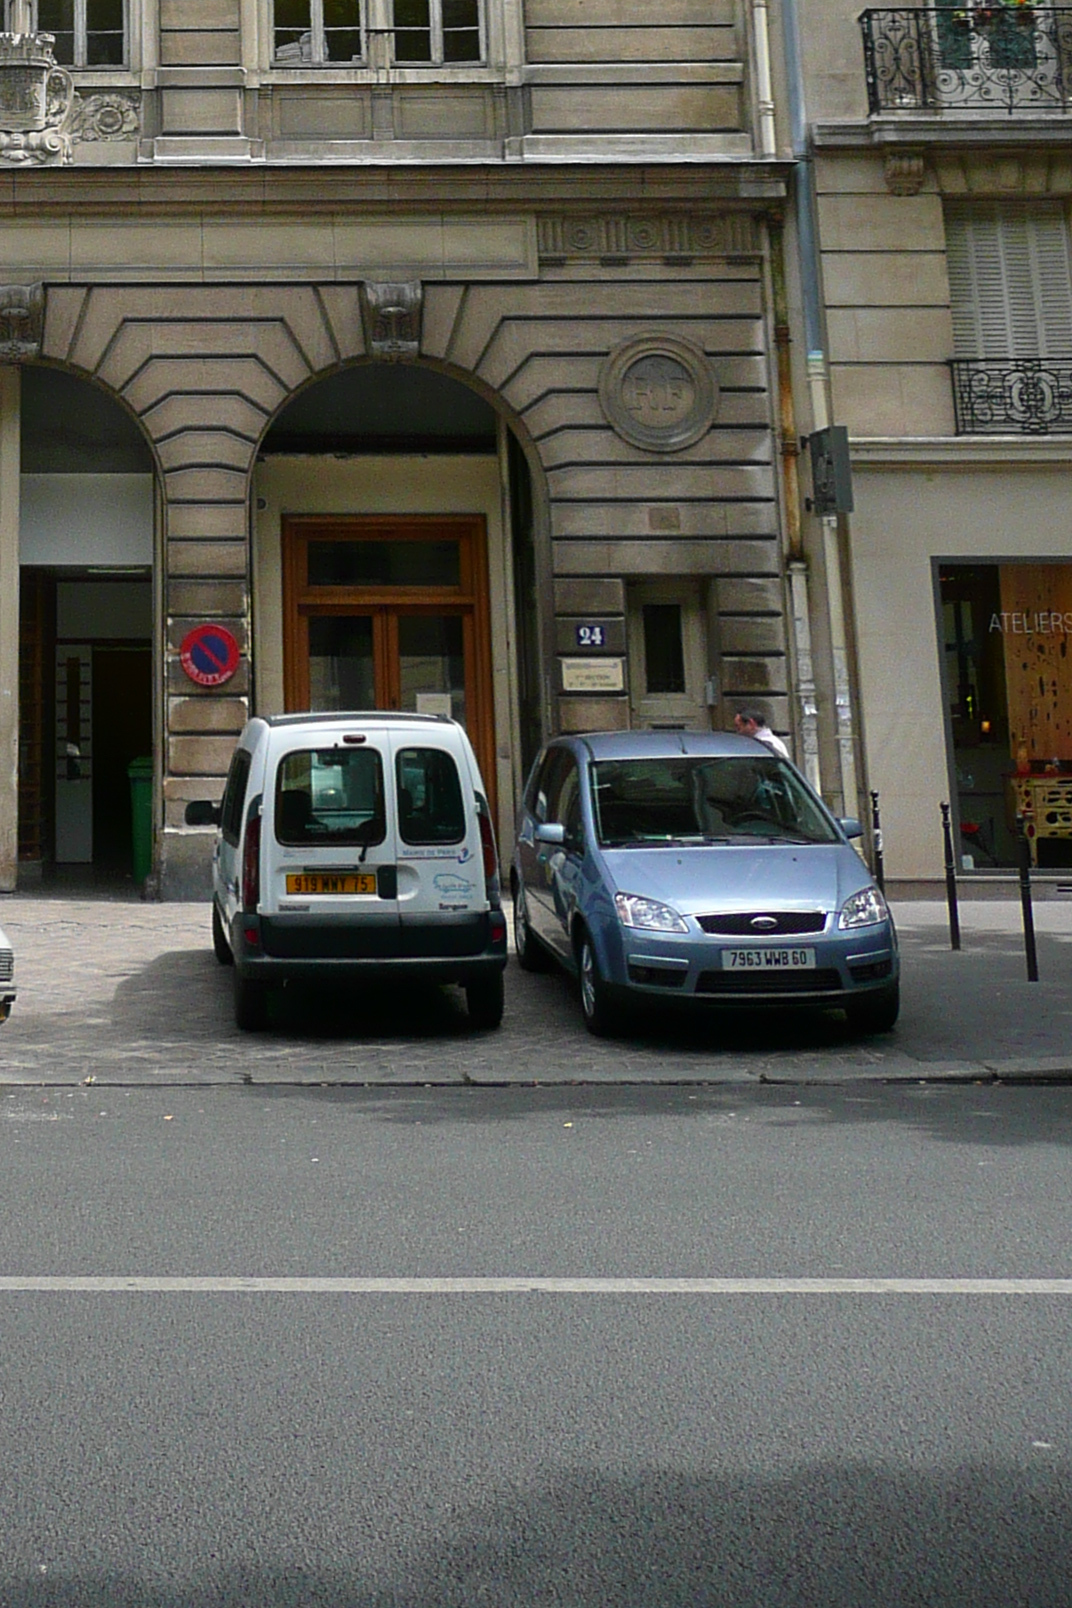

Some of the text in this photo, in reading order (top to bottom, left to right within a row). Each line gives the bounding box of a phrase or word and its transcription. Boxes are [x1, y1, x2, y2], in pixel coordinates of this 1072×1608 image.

[627, 377, 689, 410] RF
[989, 612, 1072, 633] ATELIERS
[579, 627, 602, 644] 24
[294, 876, 317, 892] 919
[353, 876, 368, 892] 75
[730, 950, 807, 967] 7963 WWB 60
